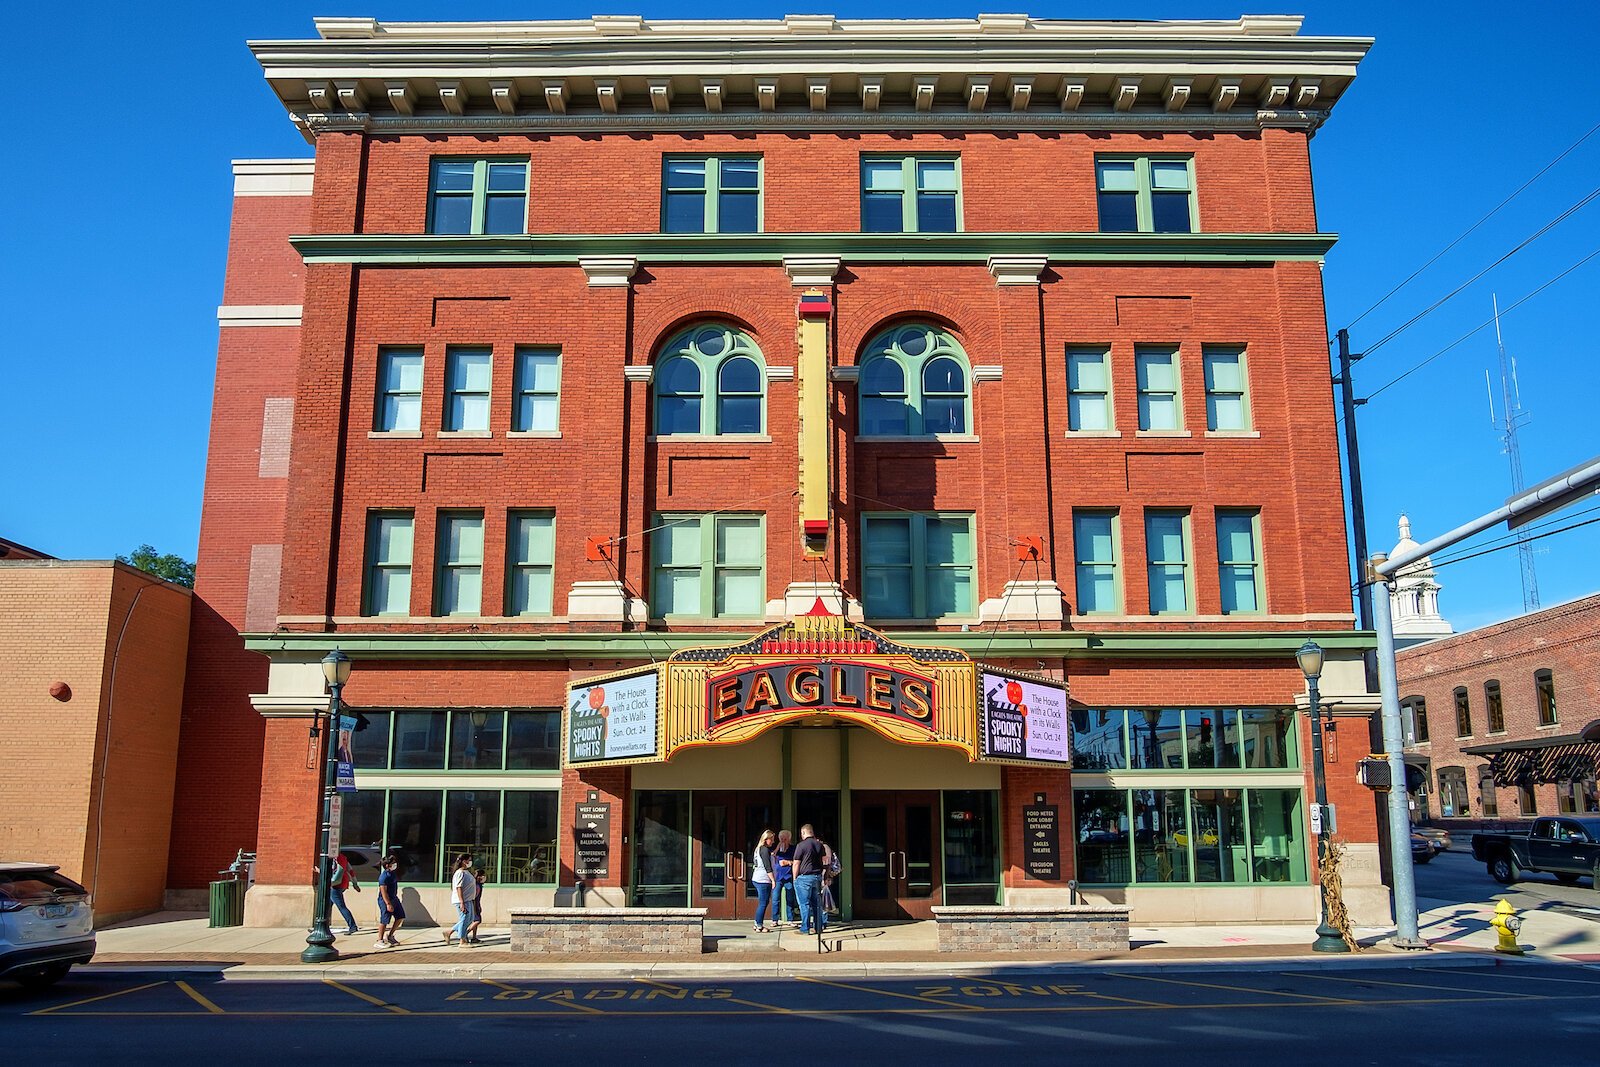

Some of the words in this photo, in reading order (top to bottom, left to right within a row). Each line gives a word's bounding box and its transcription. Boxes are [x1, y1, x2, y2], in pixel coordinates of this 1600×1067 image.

[615, 691, 625, 701] The
[627, 688, 647, 699] House
[713, 665, 931, 721] EAGLES
[612, 702, 625, 713] with
[631, 698, 649, 710] Clock
[1032, 693, 1042, 704] The
[1043, 696, 1059, 708] House
[613, 715, 620, 724] in
[629, 710, 646, 722] Walls
[1030, 706, 1042, 716] with
[1046, 708, 1062, 719] Clock
[991, 719, 1023, 738] SPOOKY
[1032, 717, 1037, 726] in
[1045, 719, 1061, 730] Walls
[573, 725, 603, 743] SPOOKY
[613, 728, 625, 737] Sun.
[626, 726, 637, 736] Oct.
[639, 725, 646, 735] 24
[1032, 730, 1042, 740] Sun.
[1043, 732, 1054, 741] Oct.
[1054, 733, 1061, 742] 24
[574, 740, 601, 758] NIGHTS
[610, 742, 647, 753] honeywellarts.org
[993, 735, 1022, 754] NIGHTS
[1031, 746, 1062, 757] honeywellarts.org
[446, 988, 734, 1001] LOADING
[914, 985, 1097, 997] ZONE
